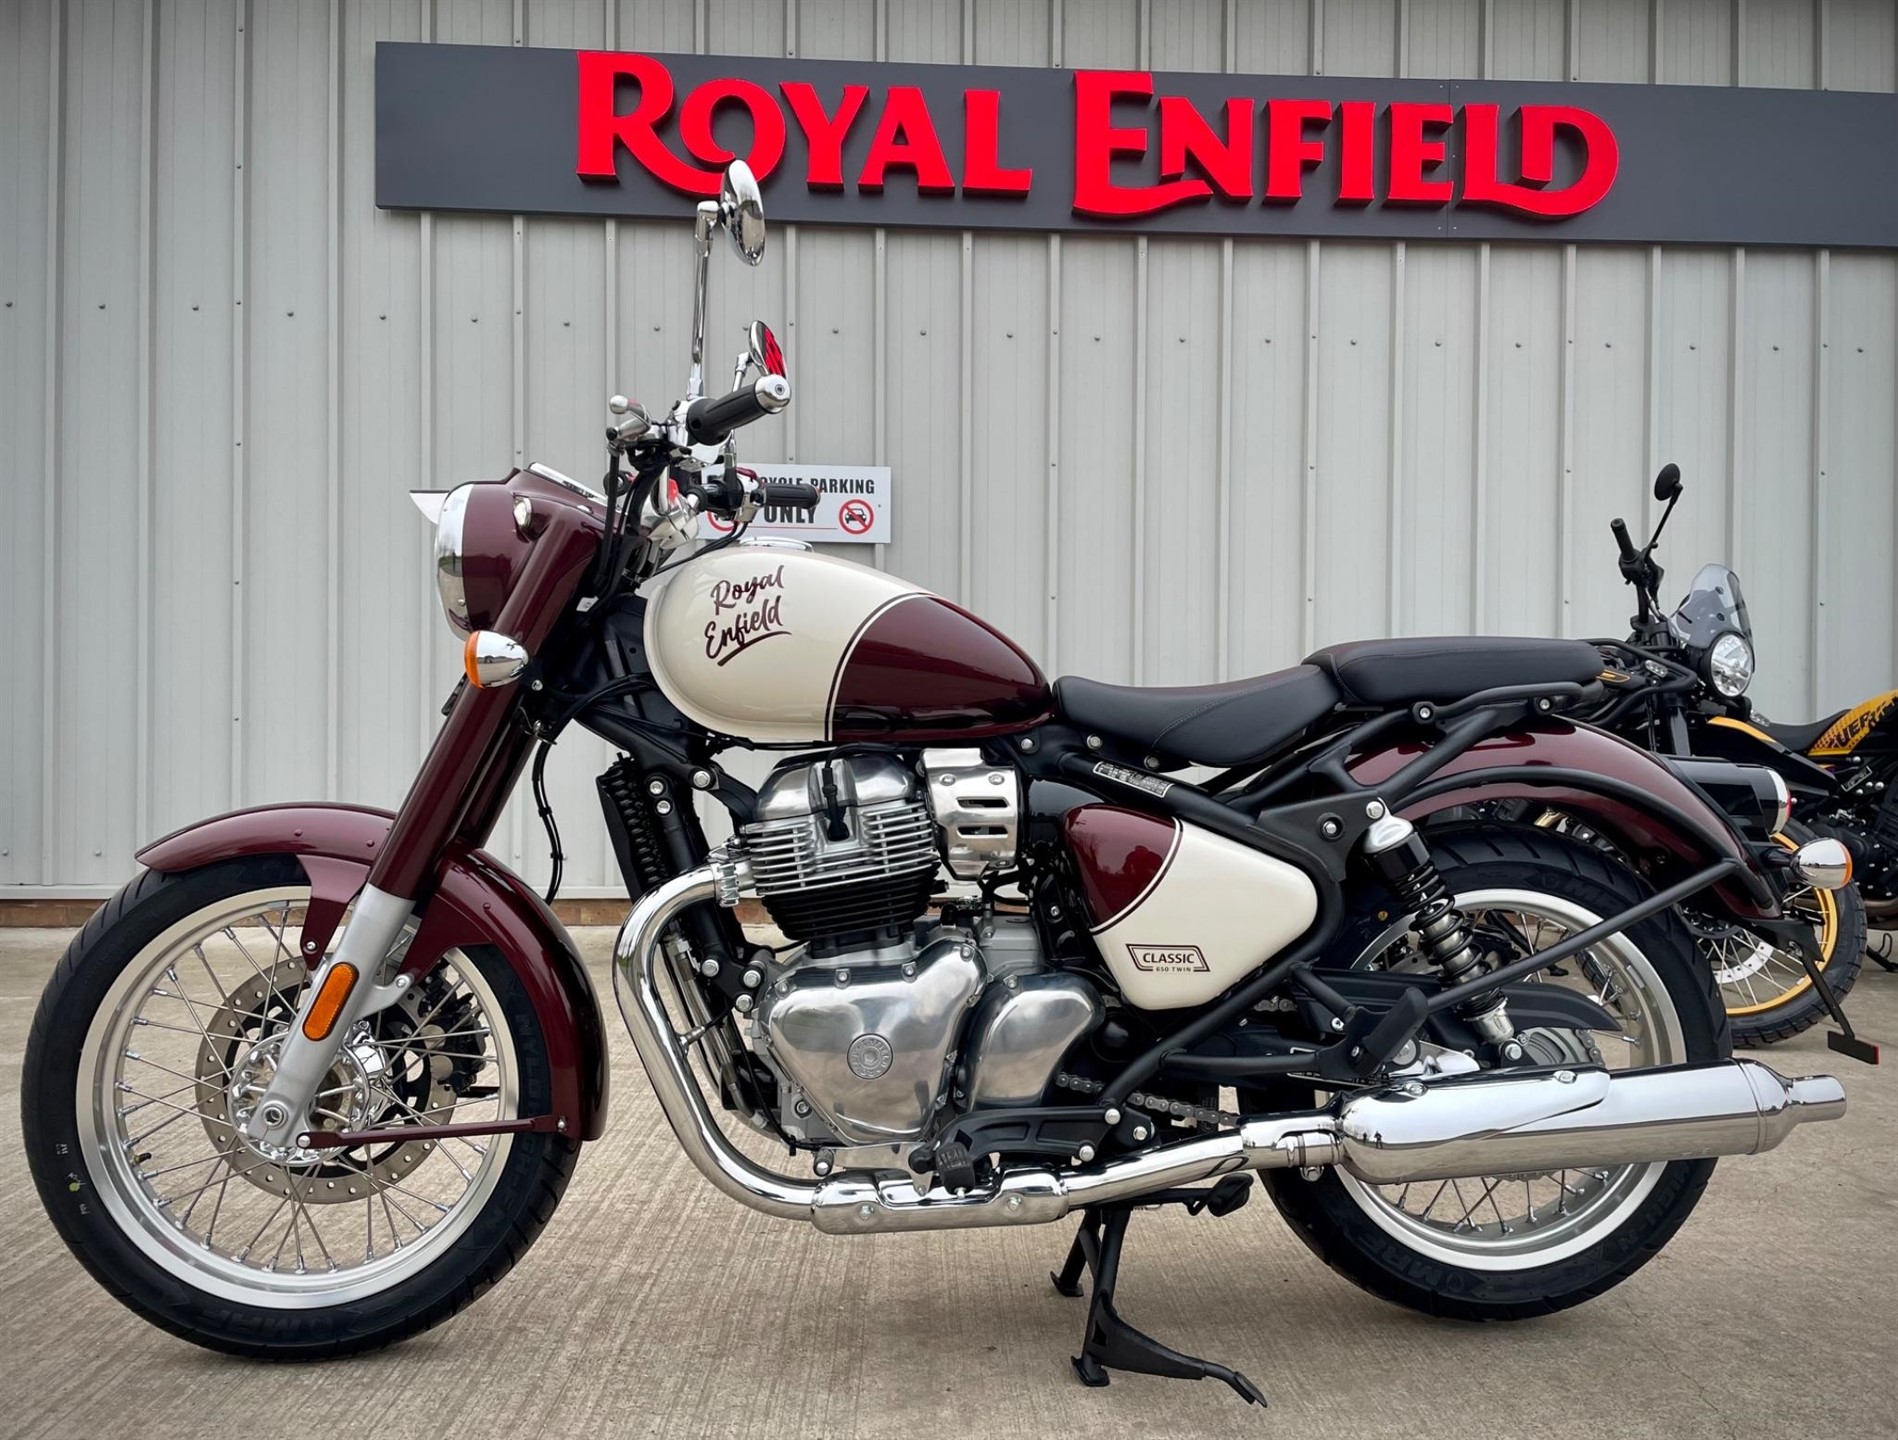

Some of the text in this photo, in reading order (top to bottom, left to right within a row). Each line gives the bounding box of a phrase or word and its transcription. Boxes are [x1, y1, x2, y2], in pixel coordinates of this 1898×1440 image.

[575, 49, 1620, 220] ROYAL ENFIELD
[710, 564, 785, 616] Royal
[704, 594, 785, 660] Enfield
[1142, 952, 1195, 964] CLASSIC
